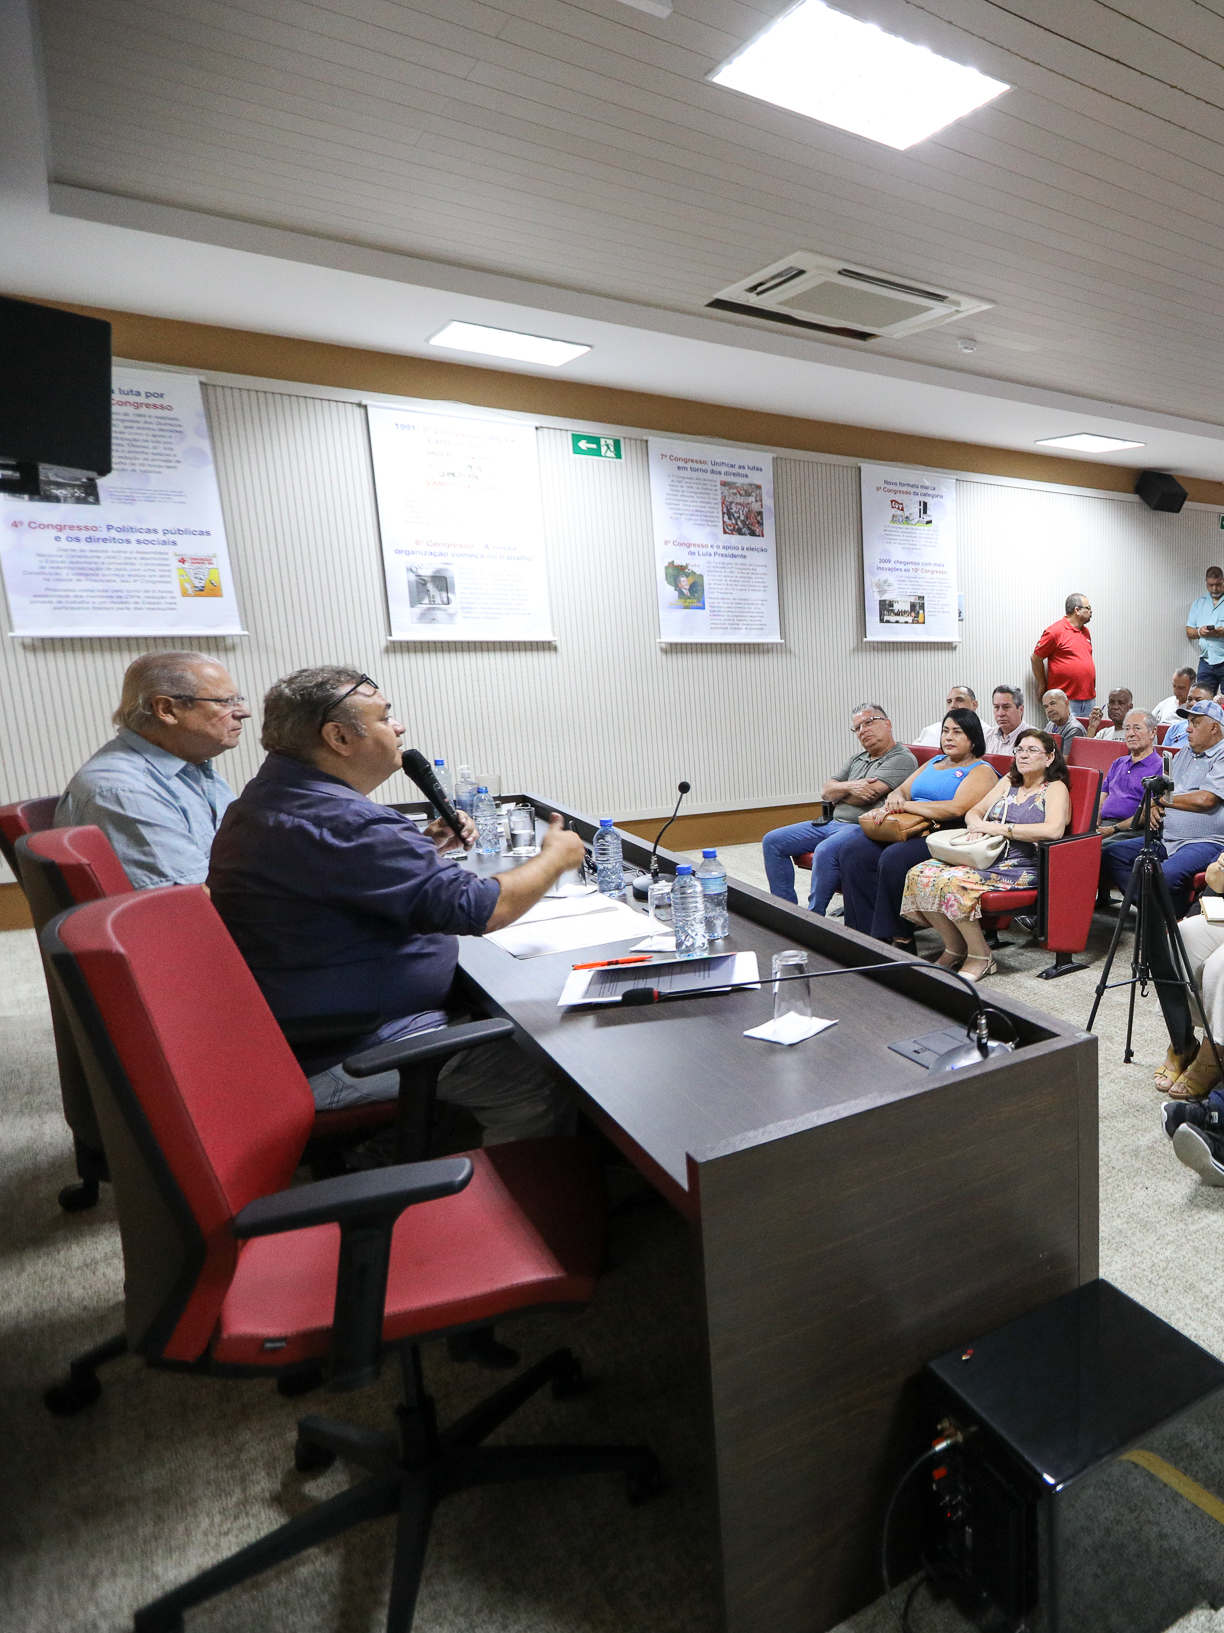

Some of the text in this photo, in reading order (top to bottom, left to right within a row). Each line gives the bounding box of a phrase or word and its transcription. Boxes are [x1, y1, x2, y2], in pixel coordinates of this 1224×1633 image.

[118, 387, 141, 397] luta
[145, 391, 165, 399] por
[710, 460, 737, 469] Unificar
[689, 466, 709, 474] torno
[723, 470, 749, 478] direitos
[898, 481, 920, 489] formato
[882, 486, 912, 495] Congresso
[919, 491, 944, 499] categoria
[11, 520, 212, 537] 4º Congresso: Políticas públicas
[65, 535, 81, 543] os
[84, 535, 132, 545] direitos
[135, 538, 178, 546] sociais
[672, 540, 709, 549] Congresso
[745, 546, 768, 554] eleição
[394, 548, 449, 558] organização
[450, 551, 486, 560] começa
[499, 554, 533, 562] trabalho
[697, 550, 713, 558] Lula
[713, 551, 748, 560] Presidente
[893, 559, 921, 567] chegamos
[920, 567, 948, 575] Congresso
